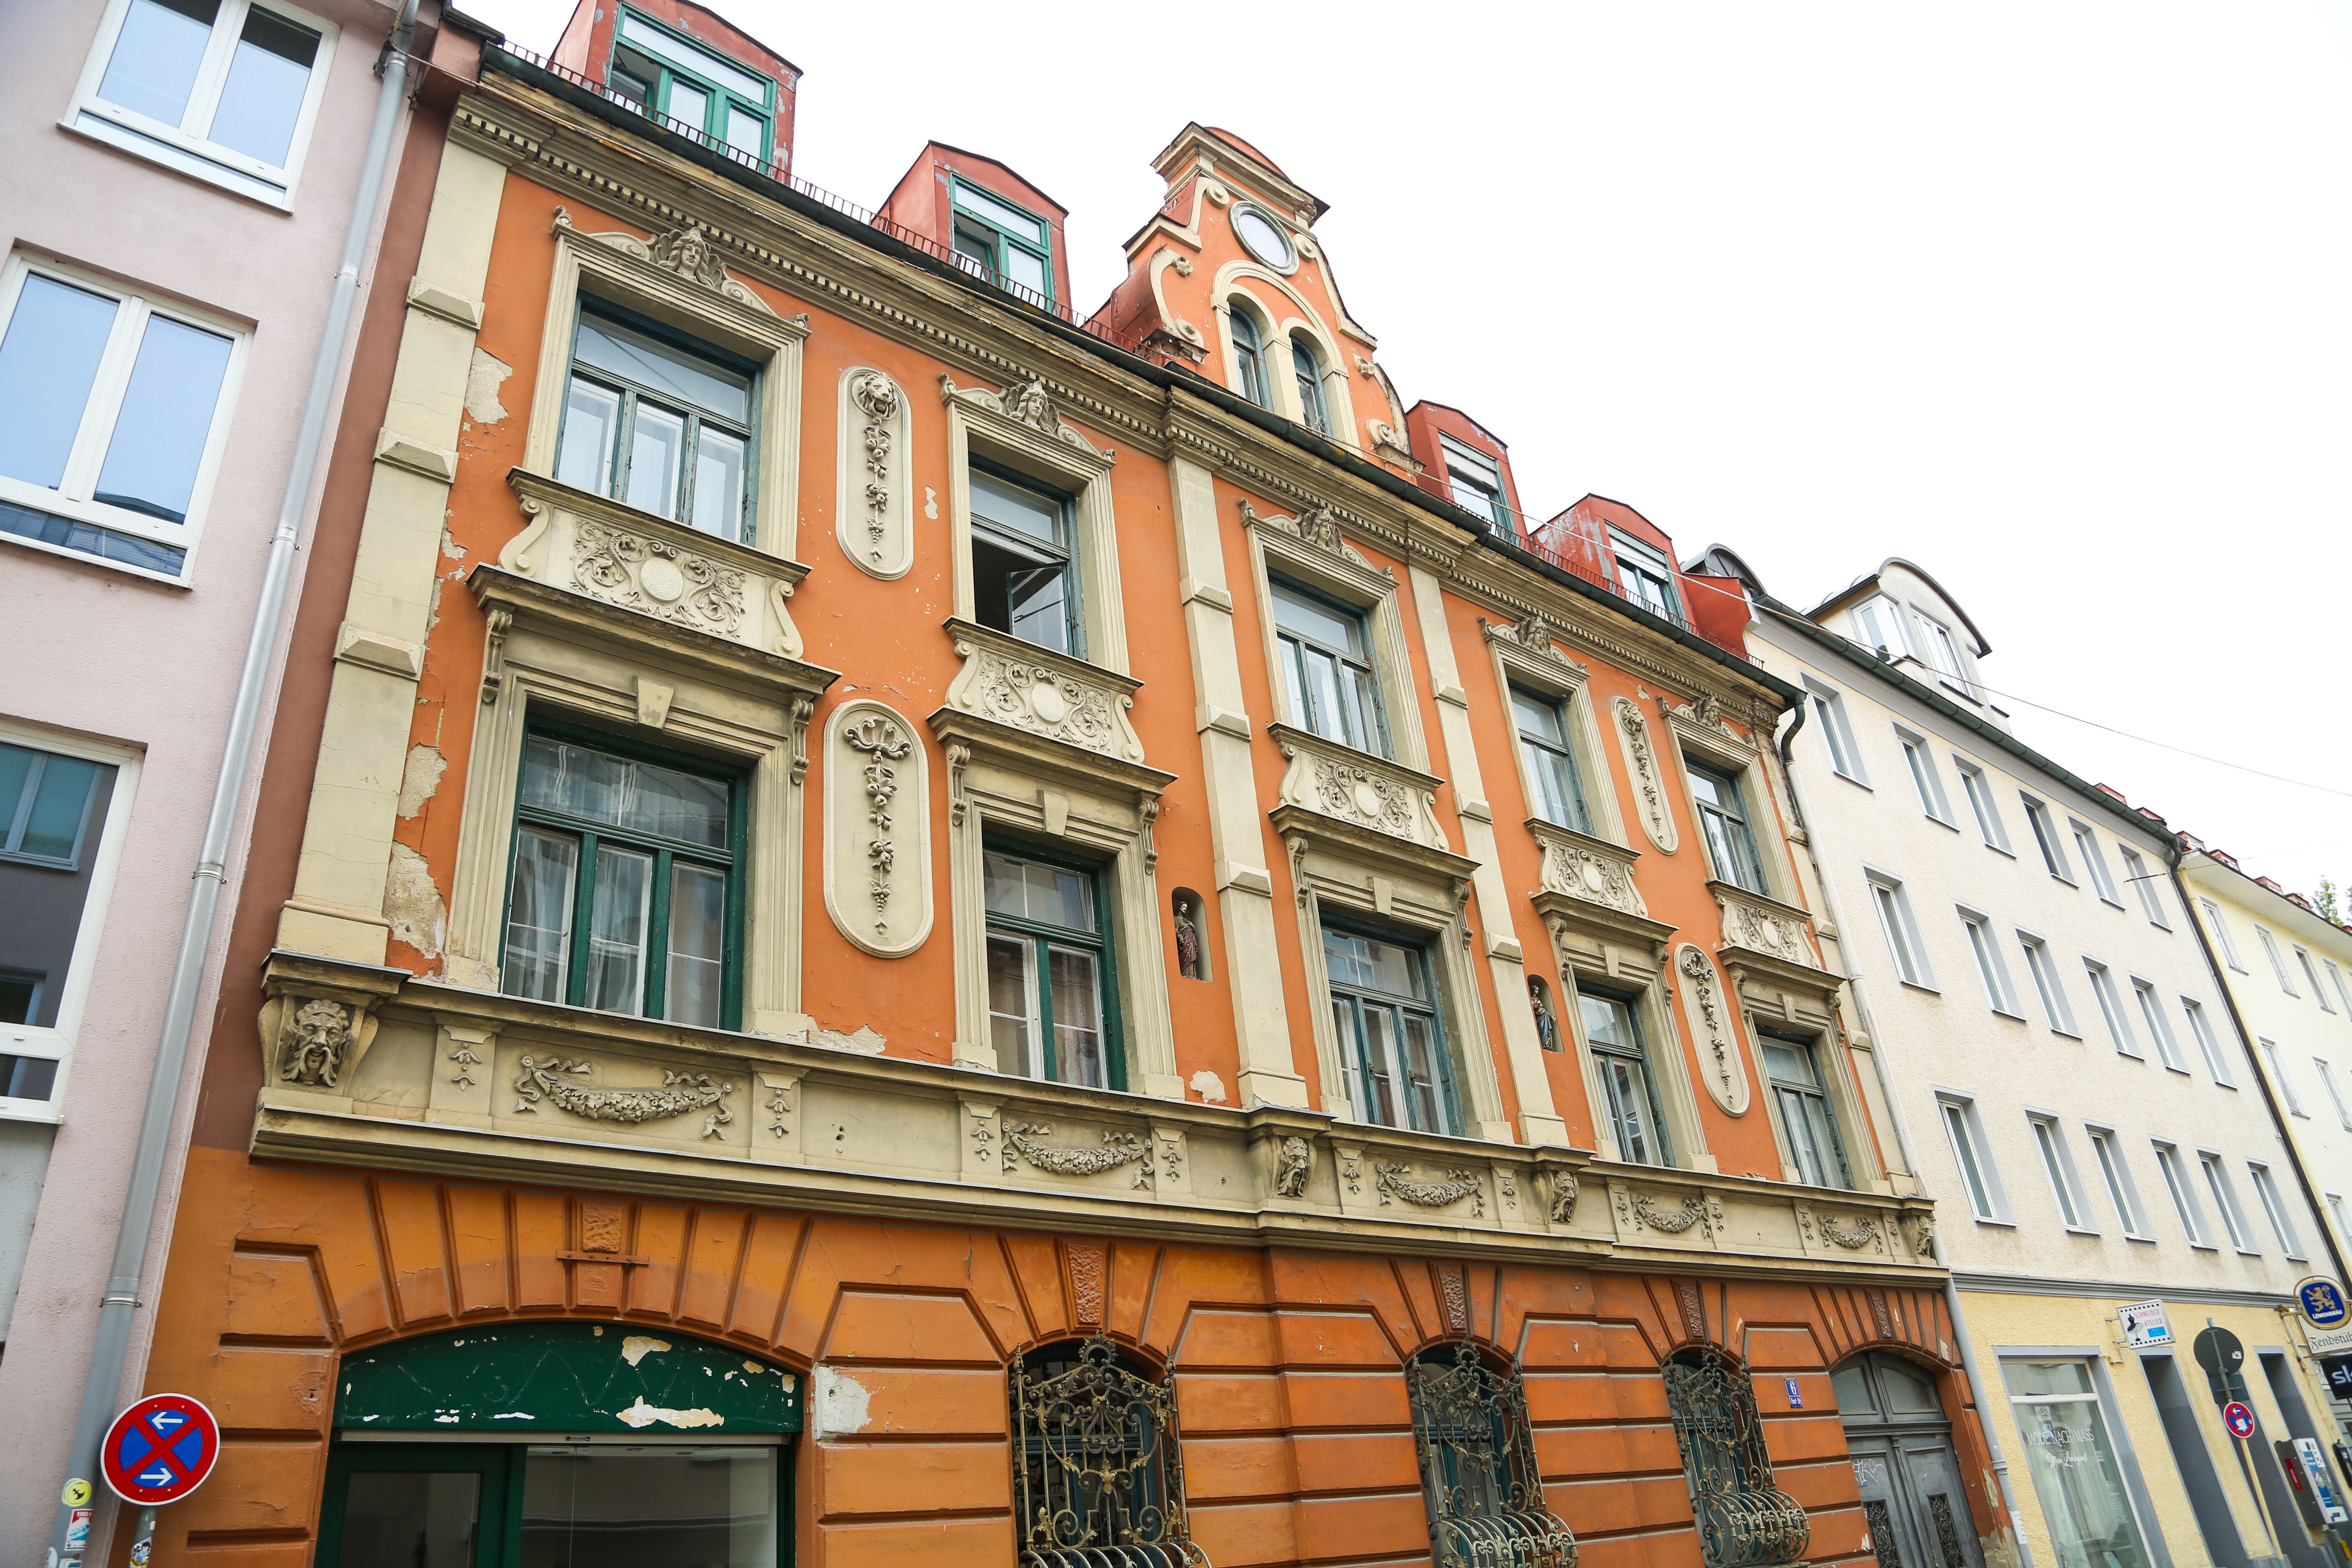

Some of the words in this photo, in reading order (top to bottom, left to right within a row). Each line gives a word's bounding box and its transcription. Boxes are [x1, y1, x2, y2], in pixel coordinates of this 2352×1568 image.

[2134, 1309, 2160, 1319] SCHNEIDER
[2144, 1318, 2163, 1327] ATELIER
[1790, 1381, 1797, 1395] 6
[2026, 1431, 2050, 1446] MODE
[2050, 1430, 2073, 1447] NACH
[2074, 1428, 2094, 1442] MASS
